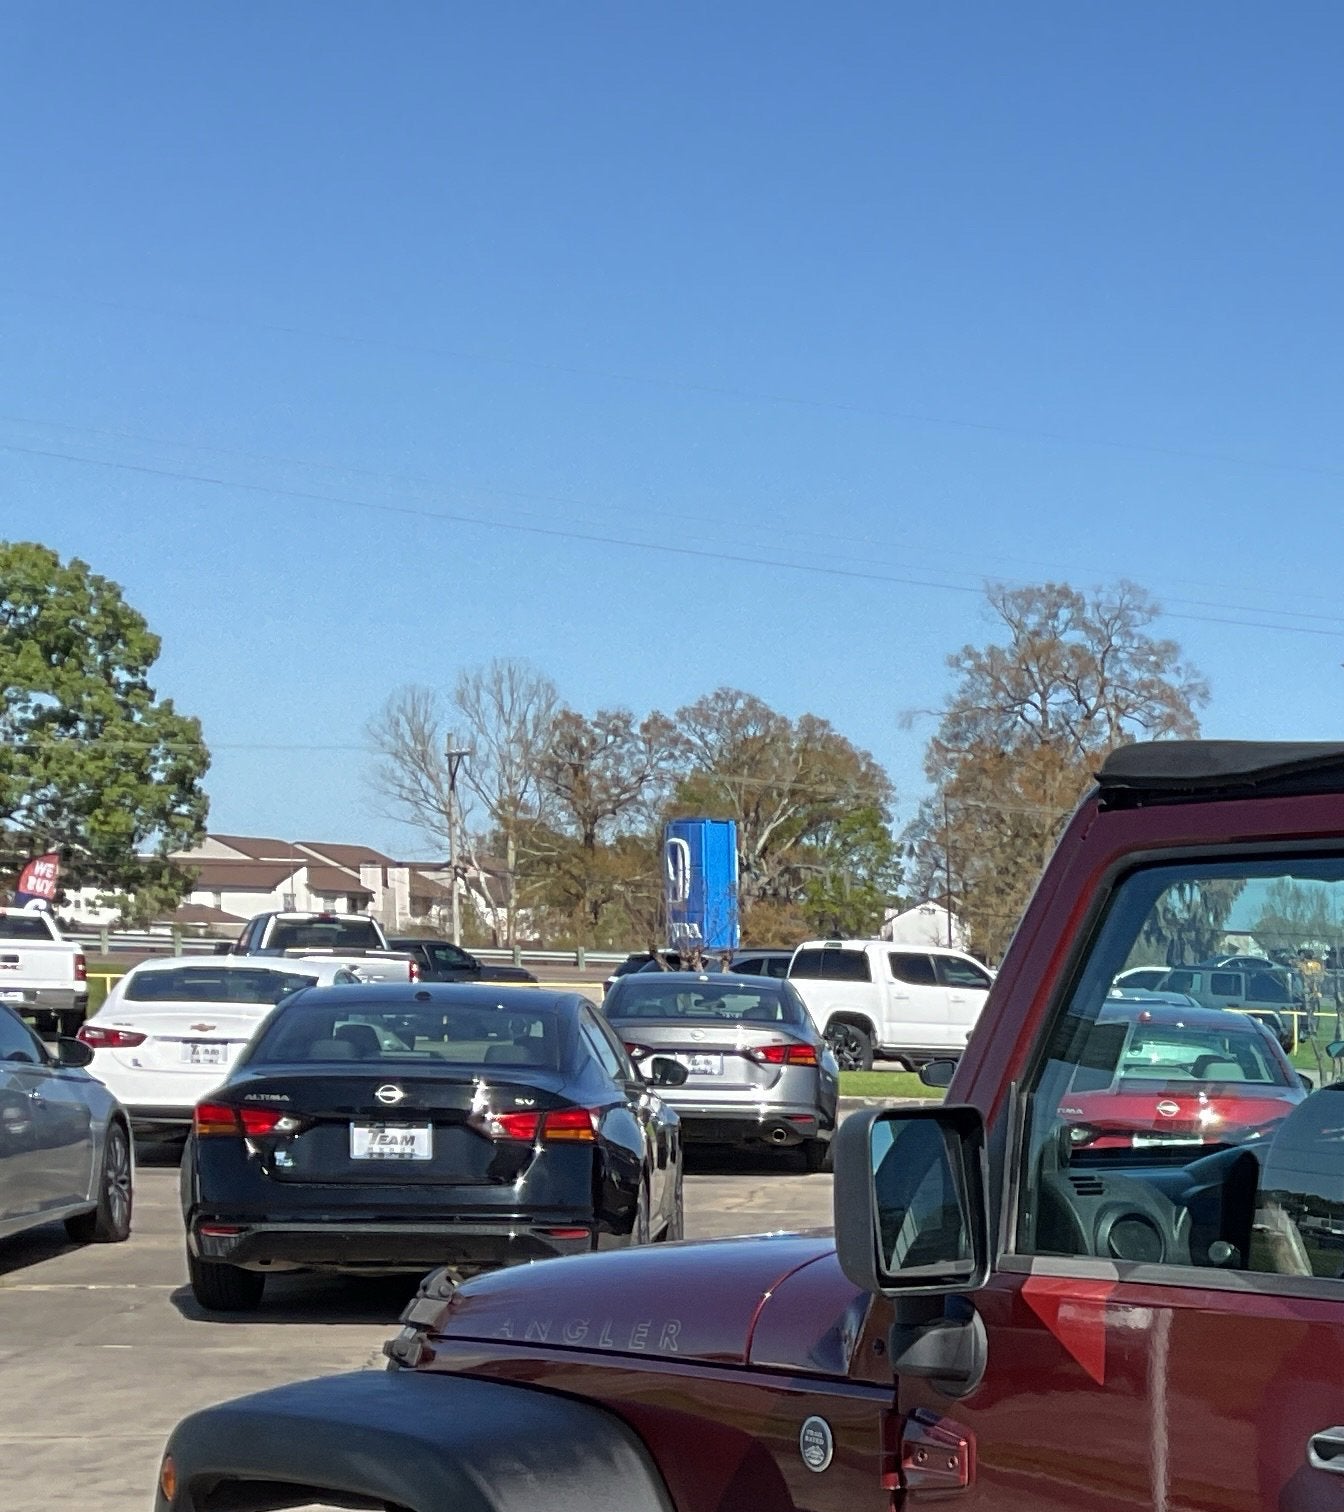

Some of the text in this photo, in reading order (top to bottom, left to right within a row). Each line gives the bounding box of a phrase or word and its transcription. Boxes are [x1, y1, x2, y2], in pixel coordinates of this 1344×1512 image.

[34, 860, 55, 878] WE
[27, 875, 55, 894] BUY
[243, 1093, 290, 1102] ALTIMA
[514, 1097, 535, 1106] SV
[367, 1127, 416, 1147] TEAM
